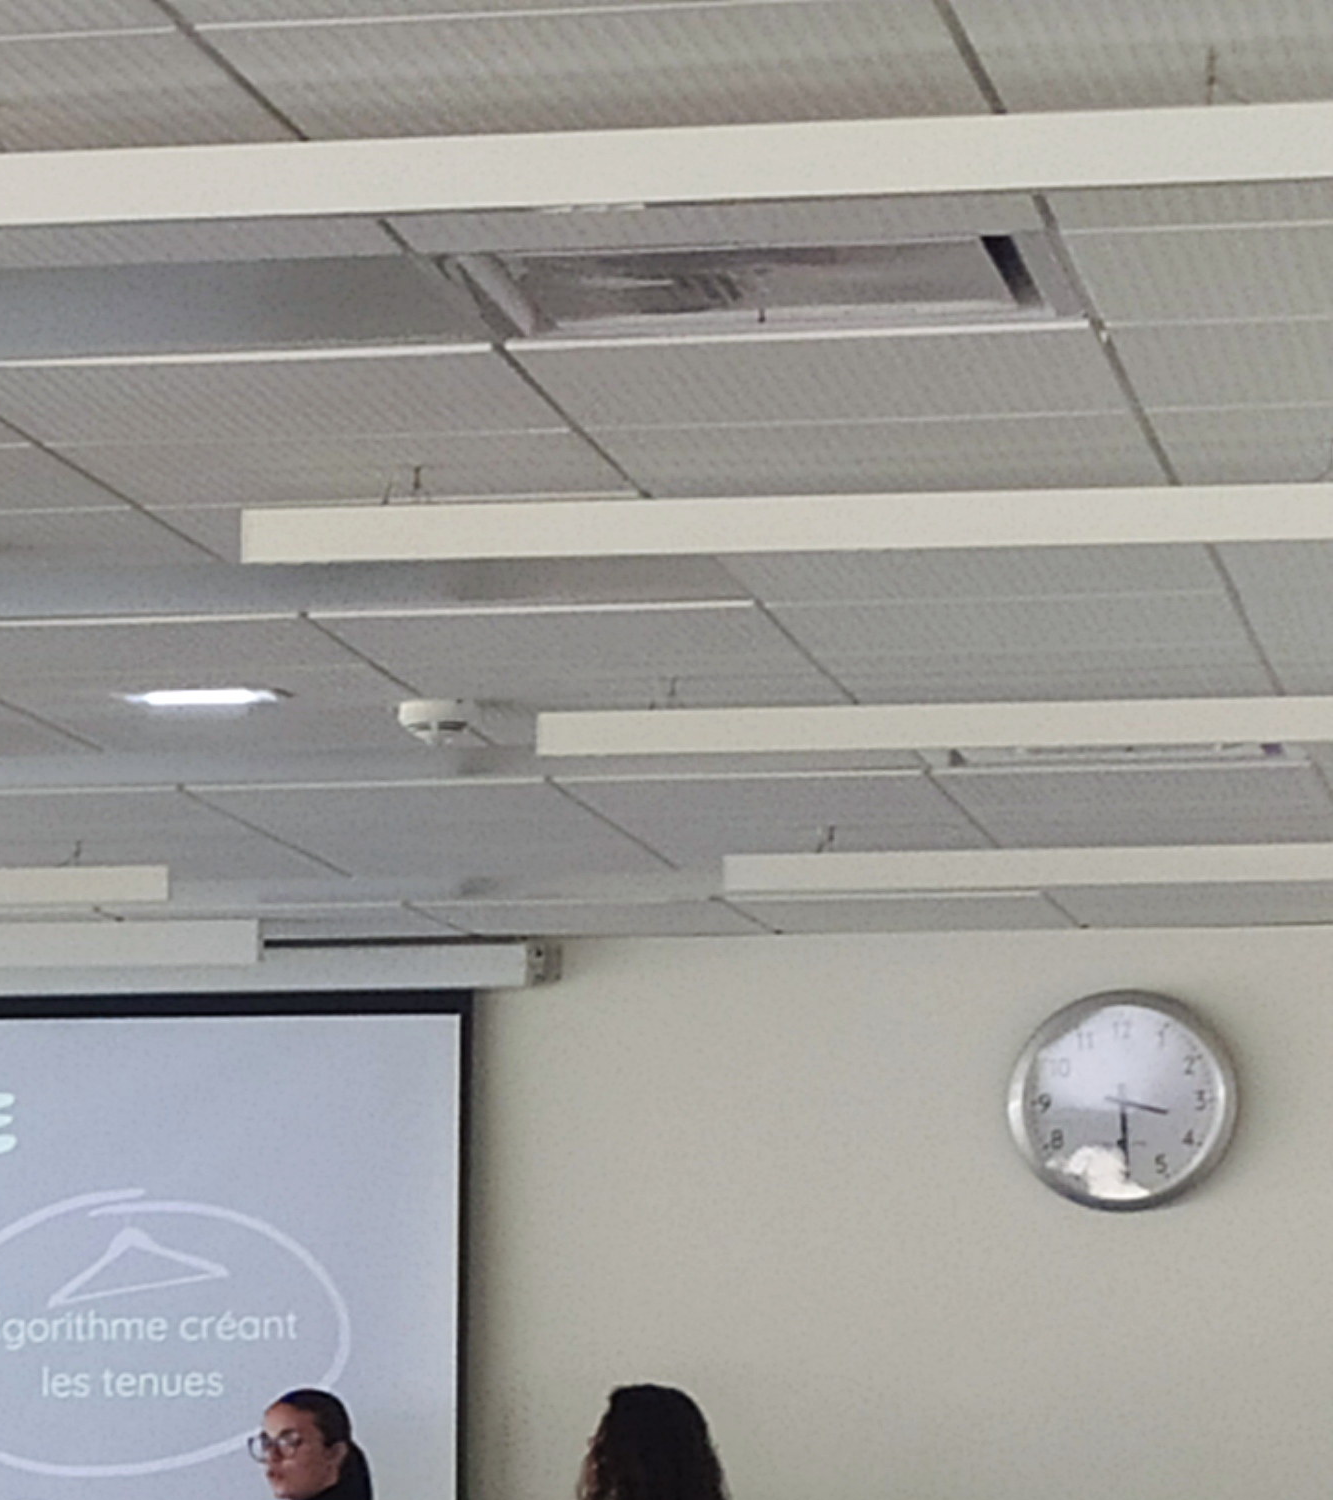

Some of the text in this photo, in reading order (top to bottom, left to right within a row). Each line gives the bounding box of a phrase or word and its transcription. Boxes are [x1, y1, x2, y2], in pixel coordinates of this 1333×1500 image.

[1037, 1092, 1052, 1113] 9
[1050, 1128, 1064, 1150] 8
[1154, 1153, 1167, 1174] 5
[179, 1308, 298, 1343] créant
[41, 1365, 224, 1399] les tenues
